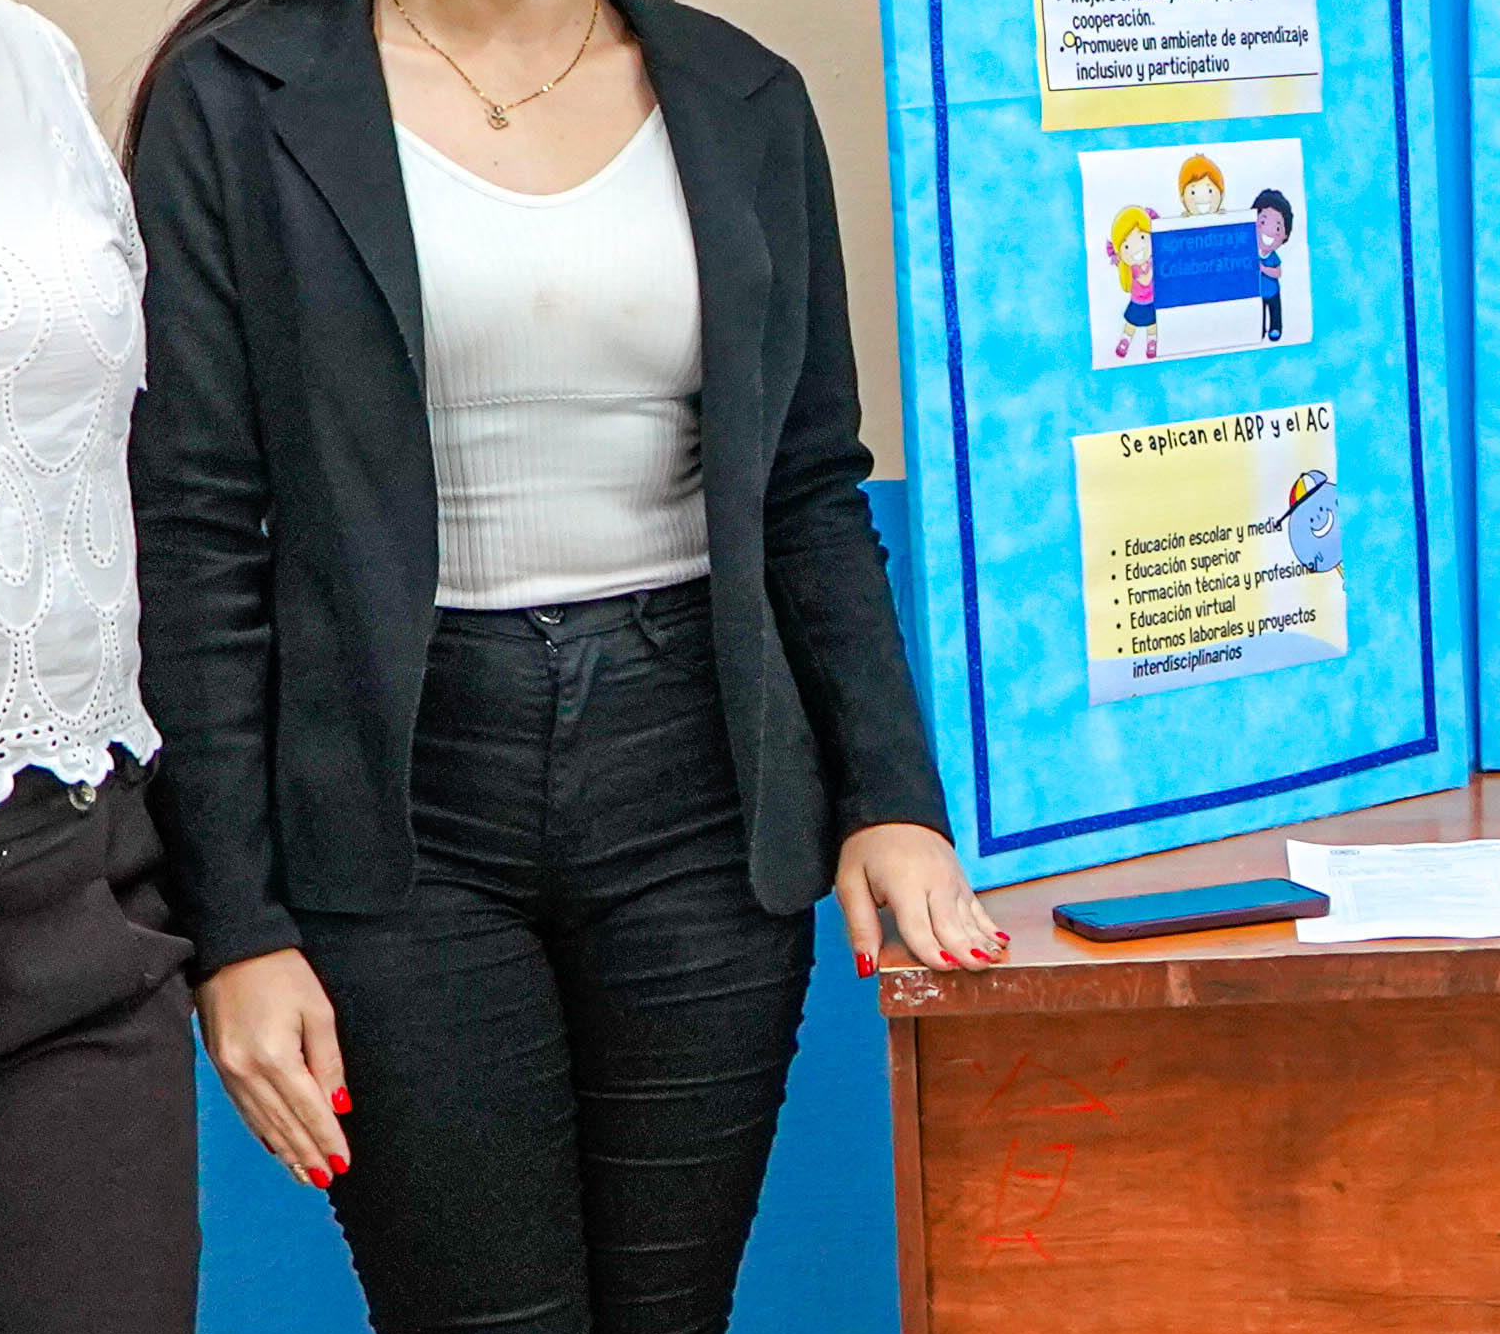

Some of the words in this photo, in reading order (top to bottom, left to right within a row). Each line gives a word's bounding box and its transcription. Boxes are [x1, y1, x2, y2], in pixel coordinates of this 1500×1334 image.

[1121, 434, 1142, 457] Se
[1149, 429, 1207, 455] aplican
[1214, 422, 1227, 441] el
[1235, 415, 1264, 442] ABP
[1271, 420, 1280, 438] y
[1287, 412, 1300, 431] el
[1307, 407, 1329, 432] AC
[1125, 533, 1185, 556] Educación
[1189, 526, 1232, 546] escolar
[1237, 527, 1243, 543] y
[1126, 556, 1186, 581] Educación
[1191, 548, 1241, 572] superior
[1130, 605, 1191, 629] Educación
[1196, 595, 1235, 618] virtual
